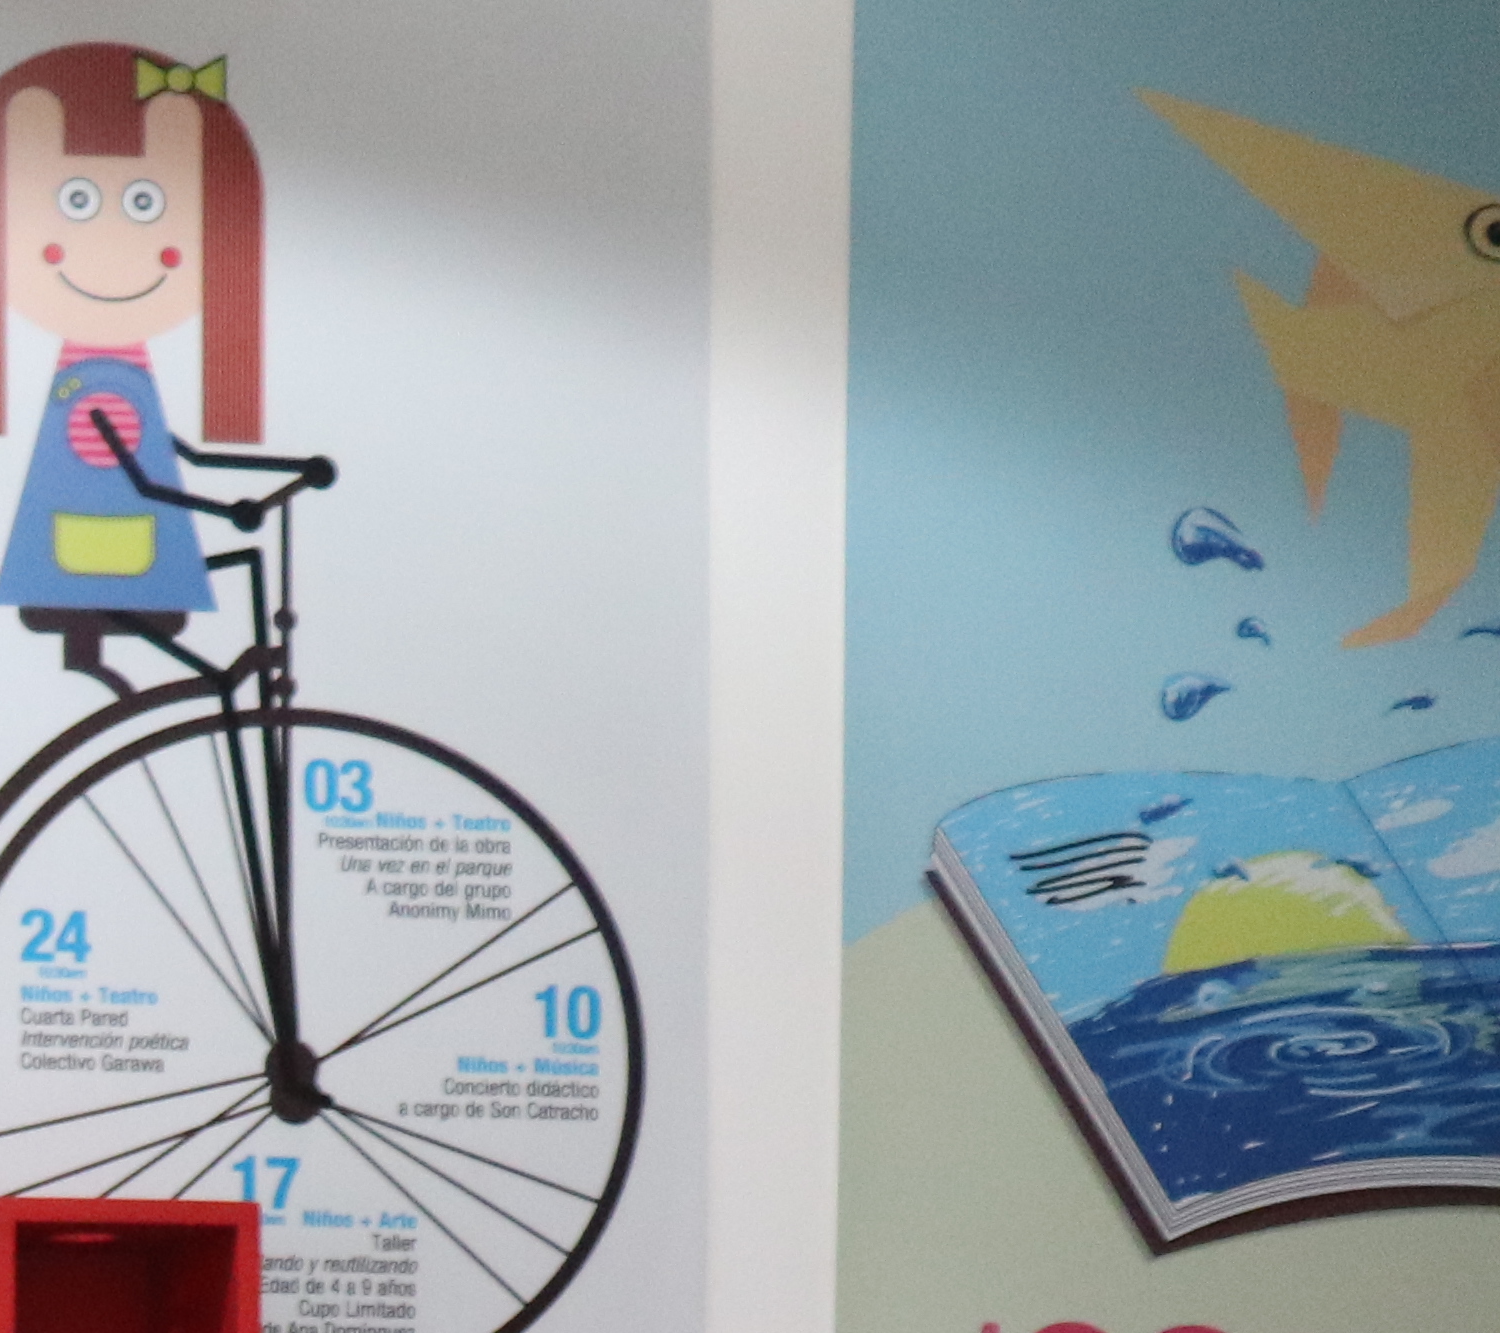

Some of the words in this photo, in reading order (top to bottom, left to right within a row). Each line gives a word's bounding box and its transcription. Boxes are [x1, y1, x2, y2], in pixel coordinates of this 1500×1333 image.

[304, 757, 375, 814] 03
[429, 836, 449, 852] de
[475, 837, 512, 854] obra
[454, 861, 513, 879] parque
[464, 883, 512, 902] grupo
[19, 907, 93, 964] 24
[20, 1007, 75, 1026] Cuarta
[80, 1008, 130, 1027] Pared
[534, 983, 604, 1041] 10
[20, 1052, 96, 1071] Colectivo
[444, 1077, 521, 1098] Concierto
[413, 1103, 460, 1121] cargo
[465, 1101, 485, 1118] de
[231, 1155, 300, 1211] 17
[305, 1279, 325, 1295] de
[299, 1299, 340, 1320] Cupo
[345, 1301, 417, 1320] Limitado
